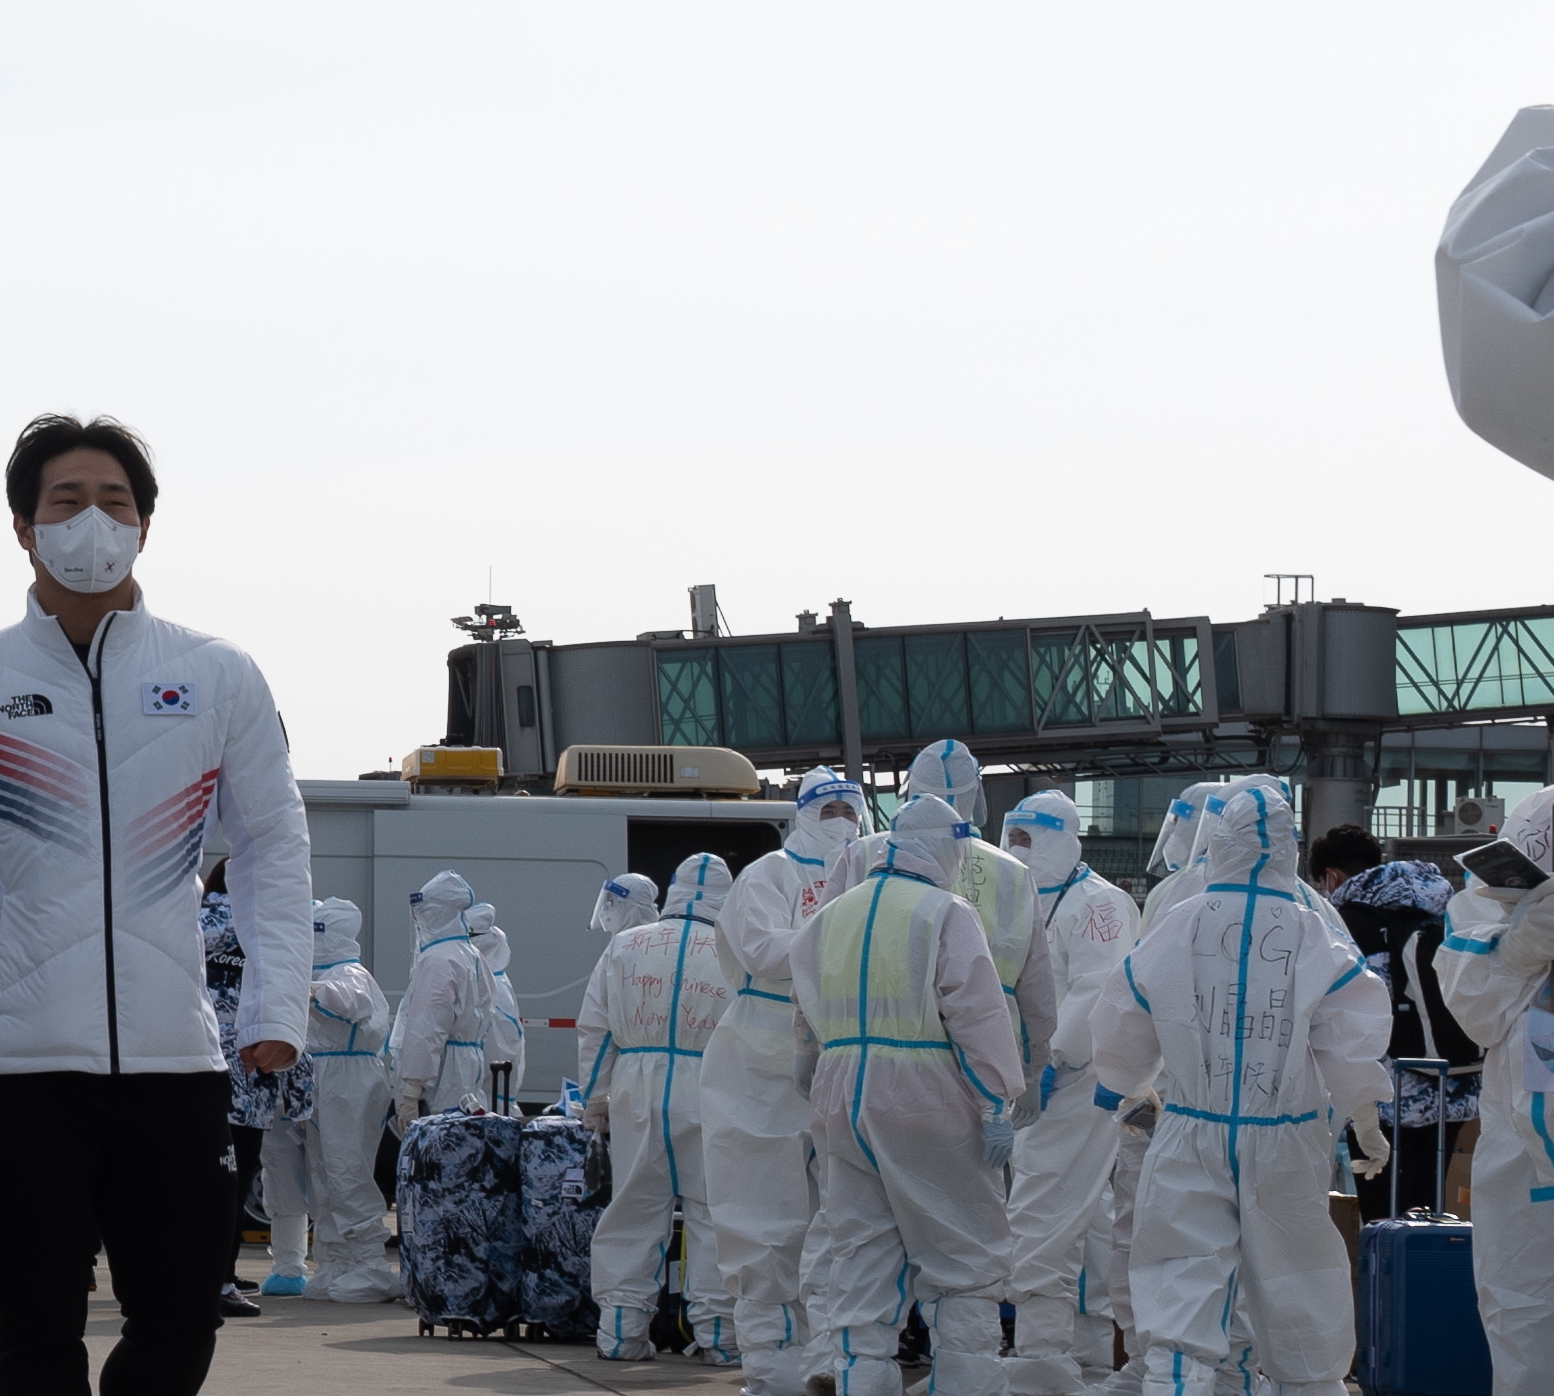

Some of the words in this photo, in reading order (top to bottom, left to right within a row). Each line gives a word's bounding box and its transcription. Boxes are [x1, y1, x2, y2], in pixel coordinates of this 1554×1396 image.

[11, 694, 34, 705] THE
[7, 709, 35, 720] FACE
[1081, 902, 1124, 943] 福
[621, 962, 664, 999] Happy
[669, 970, 728, 1000] Chinese
[681, 1003, 718, 1030] Year
